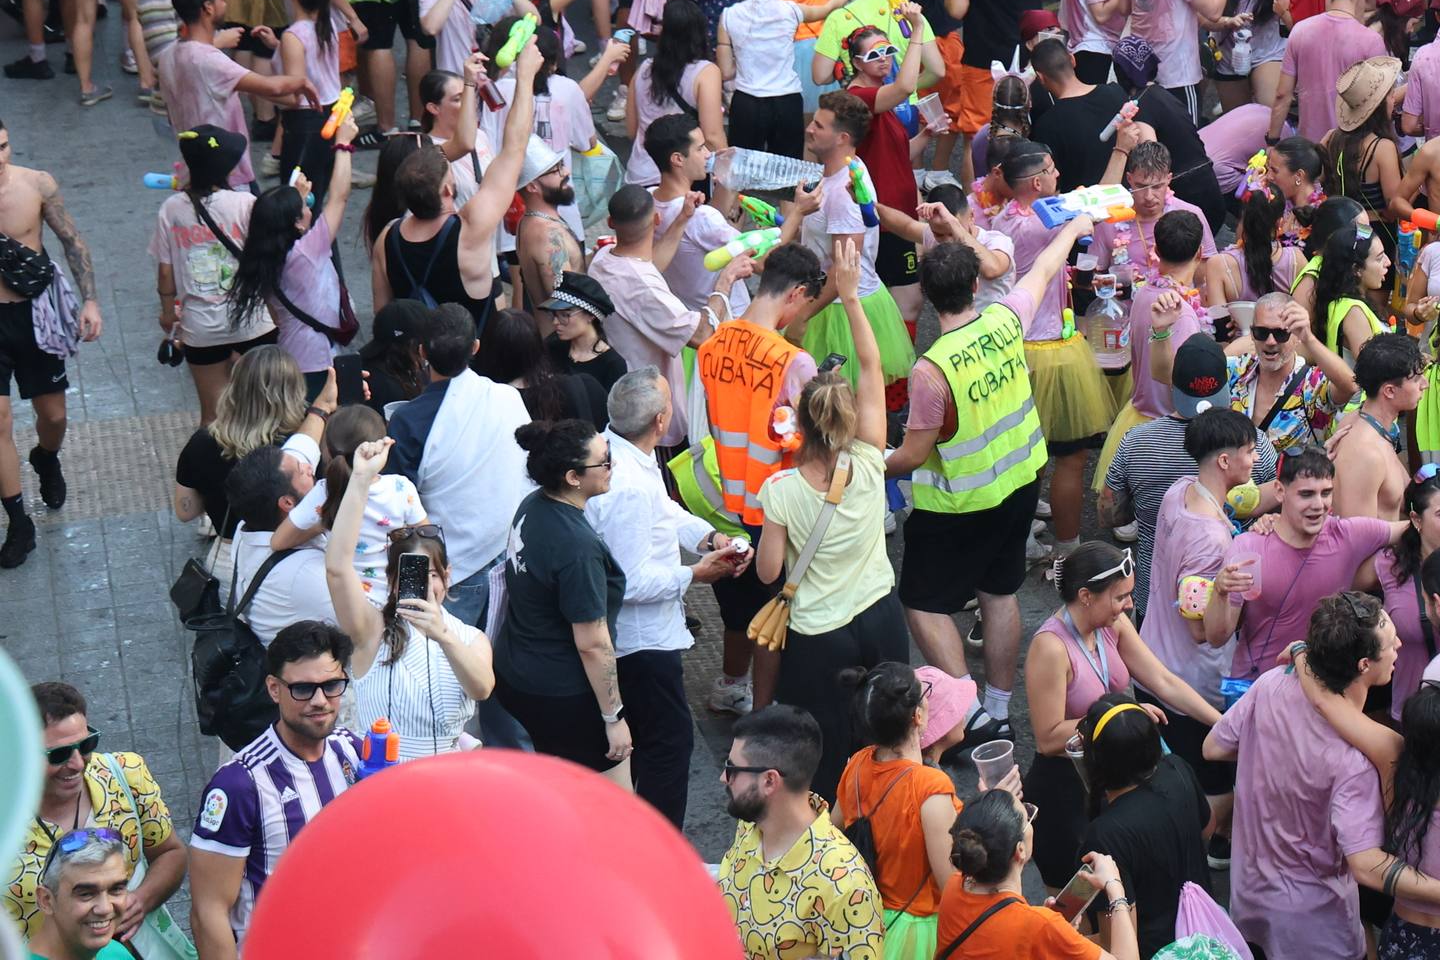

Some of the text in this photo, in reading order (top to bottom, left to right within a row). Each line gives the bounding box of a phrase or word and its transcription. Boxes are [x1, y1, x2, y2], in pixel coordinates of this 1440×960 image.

[949, 317, 1022, 372] PATRULLA
[703, 352, 774, 399] CUBATA
[968, 353, 1026, 402] CUBATA
